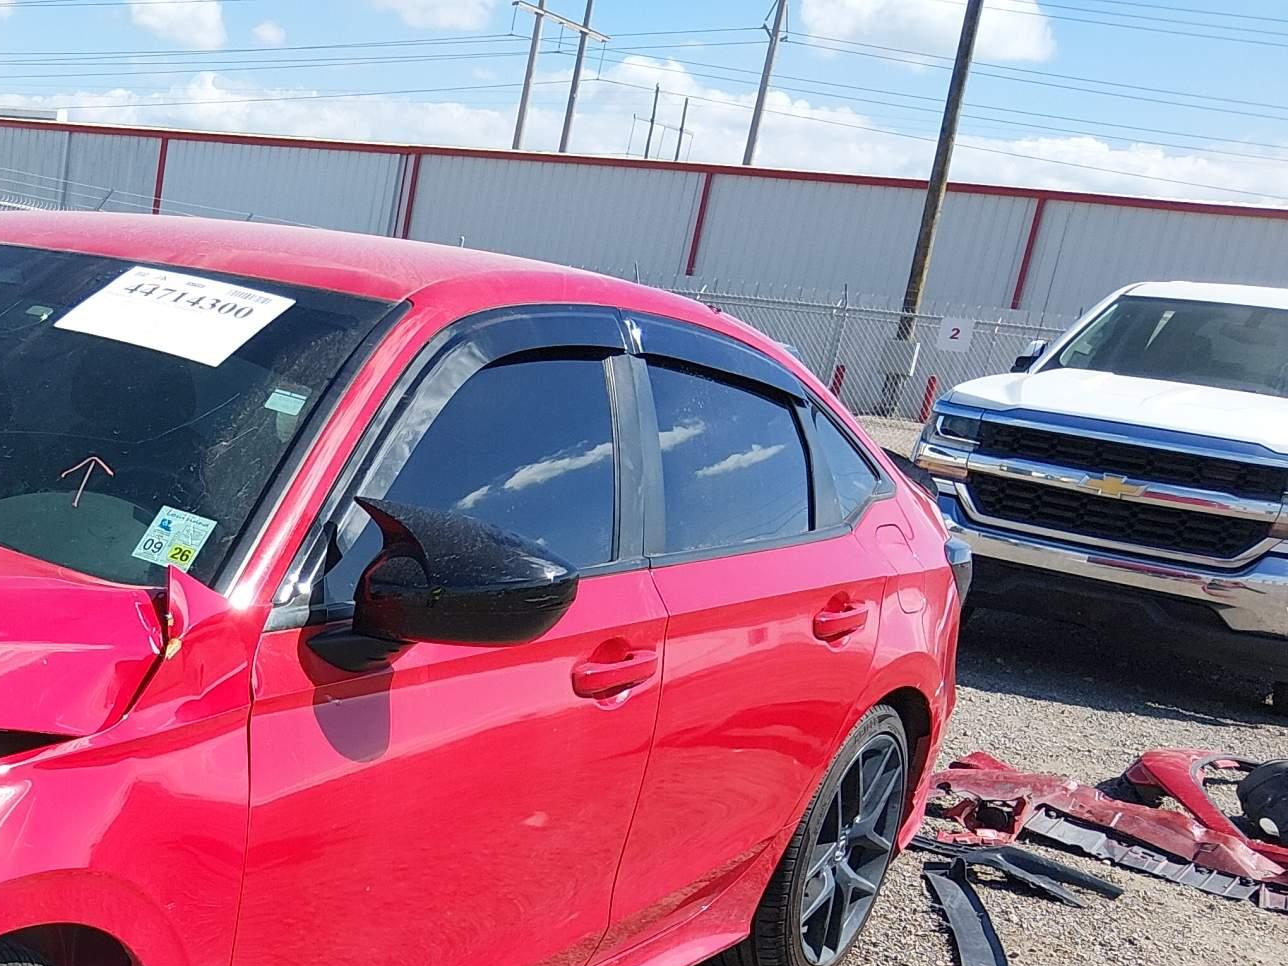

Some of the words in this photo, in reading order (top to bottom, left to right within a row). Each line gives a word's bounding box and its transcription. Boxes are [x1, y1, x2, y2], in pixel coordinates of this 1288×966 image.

[123, 282, 254, 319] 44714300
[949, 327, 961, 340] 2
[142, 538, 164, 554] 09
[170, 546, 192, 562] 26
